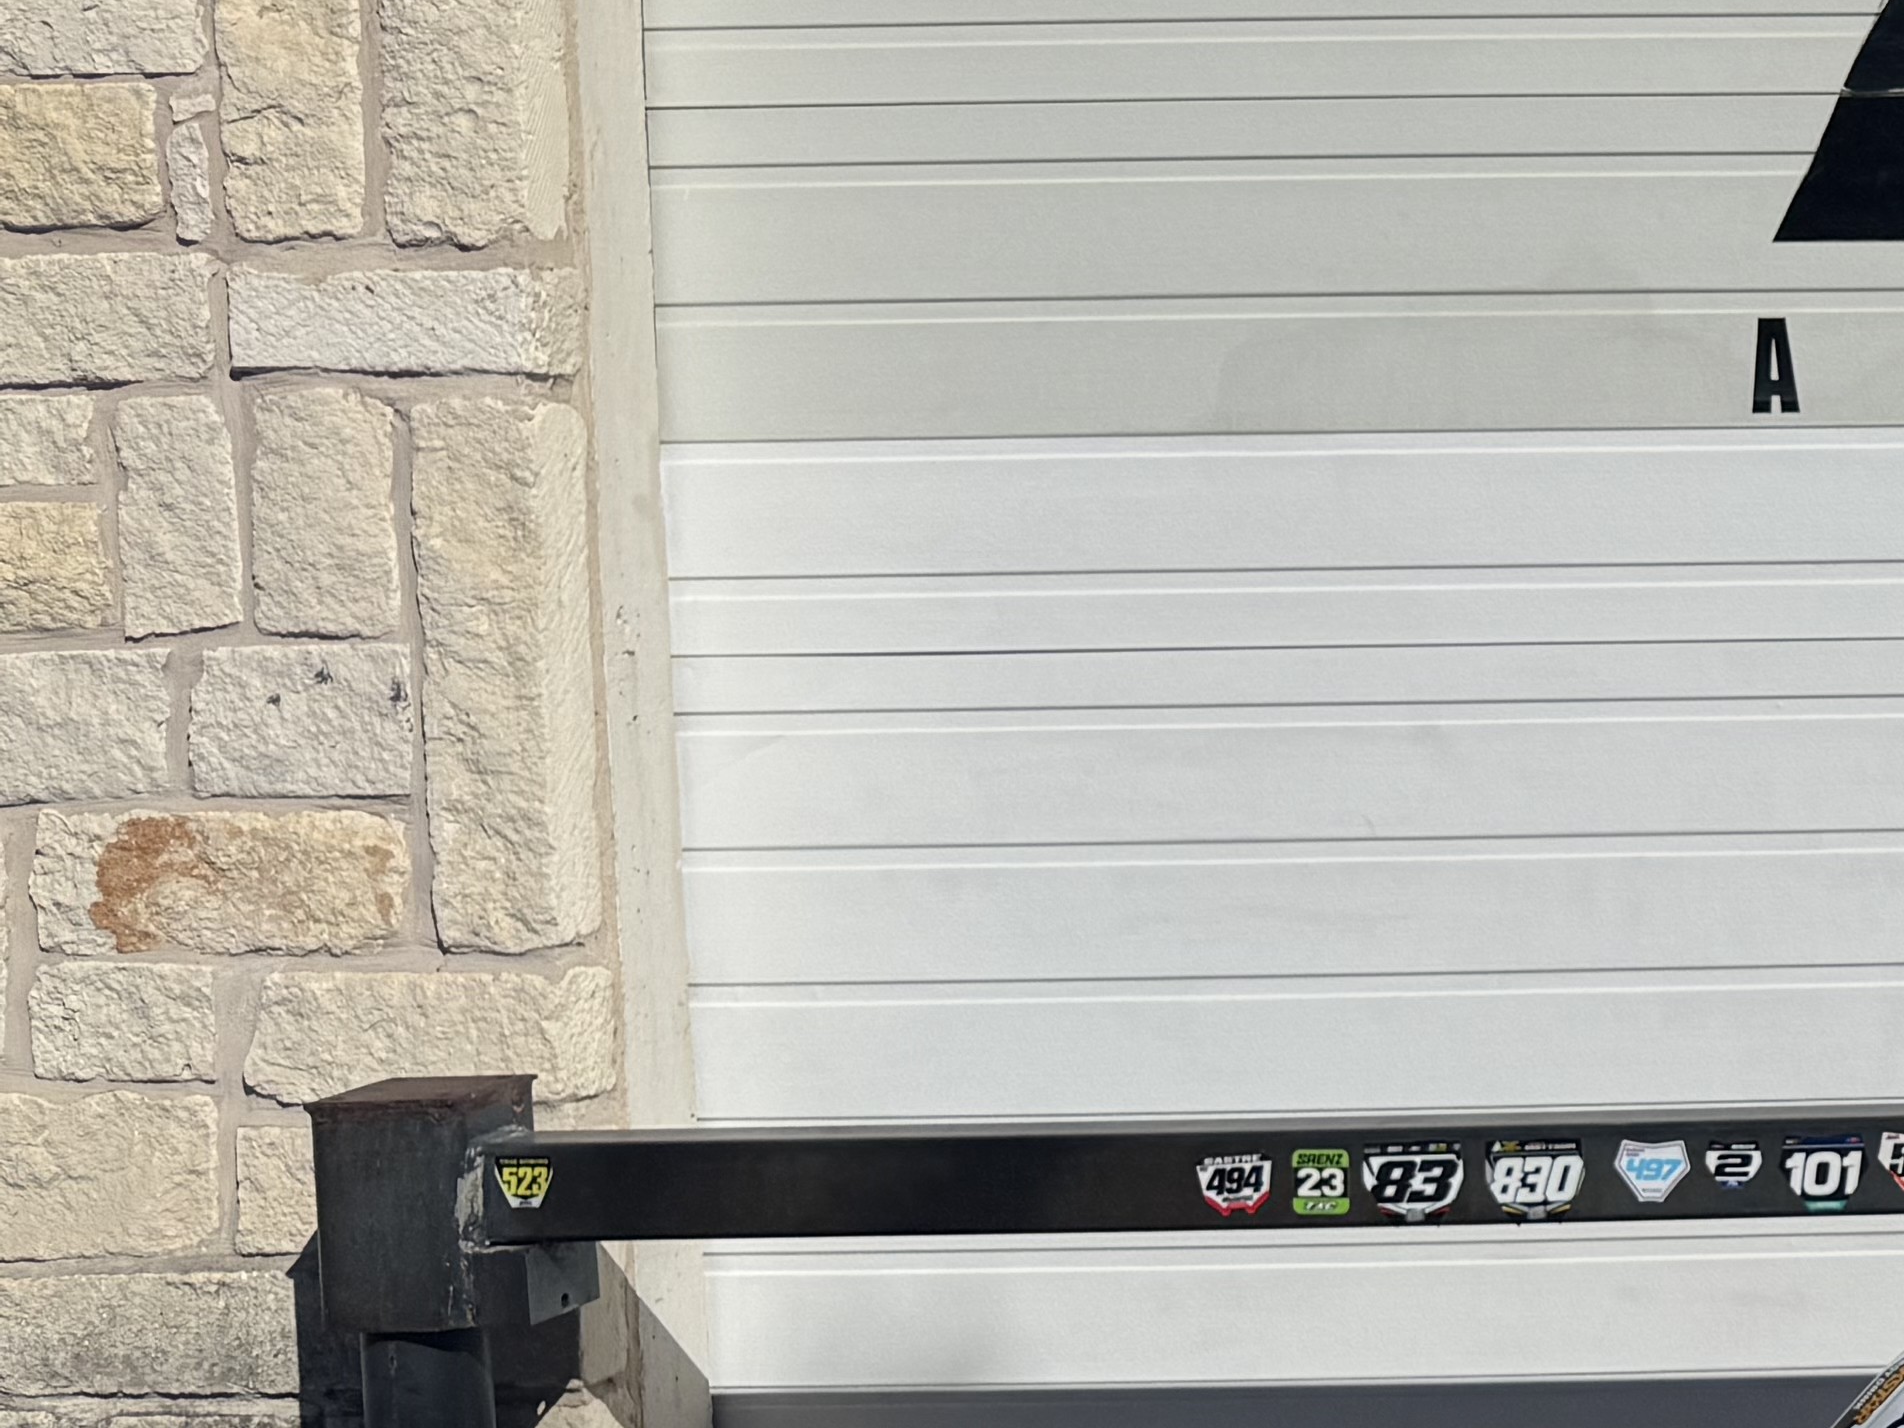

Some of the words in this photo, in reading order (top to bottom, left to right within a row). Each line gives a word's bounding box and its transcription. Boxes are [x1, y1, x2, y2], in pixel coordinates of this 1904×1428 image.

[1490, 1155, 1584, 1203] 830
[1626, 1158, 1683, 1181] 497
[1714, 1153, 1754, 1177] 2
[1785, 1150, 1863, 1196] 101
[502, 1167, 548, 1196] 523
[1206, 1165, 1264, 1196] 494
[1297, 1167, 1345, 1197] 23
[1371, 1159, 1459, 1203] 83
